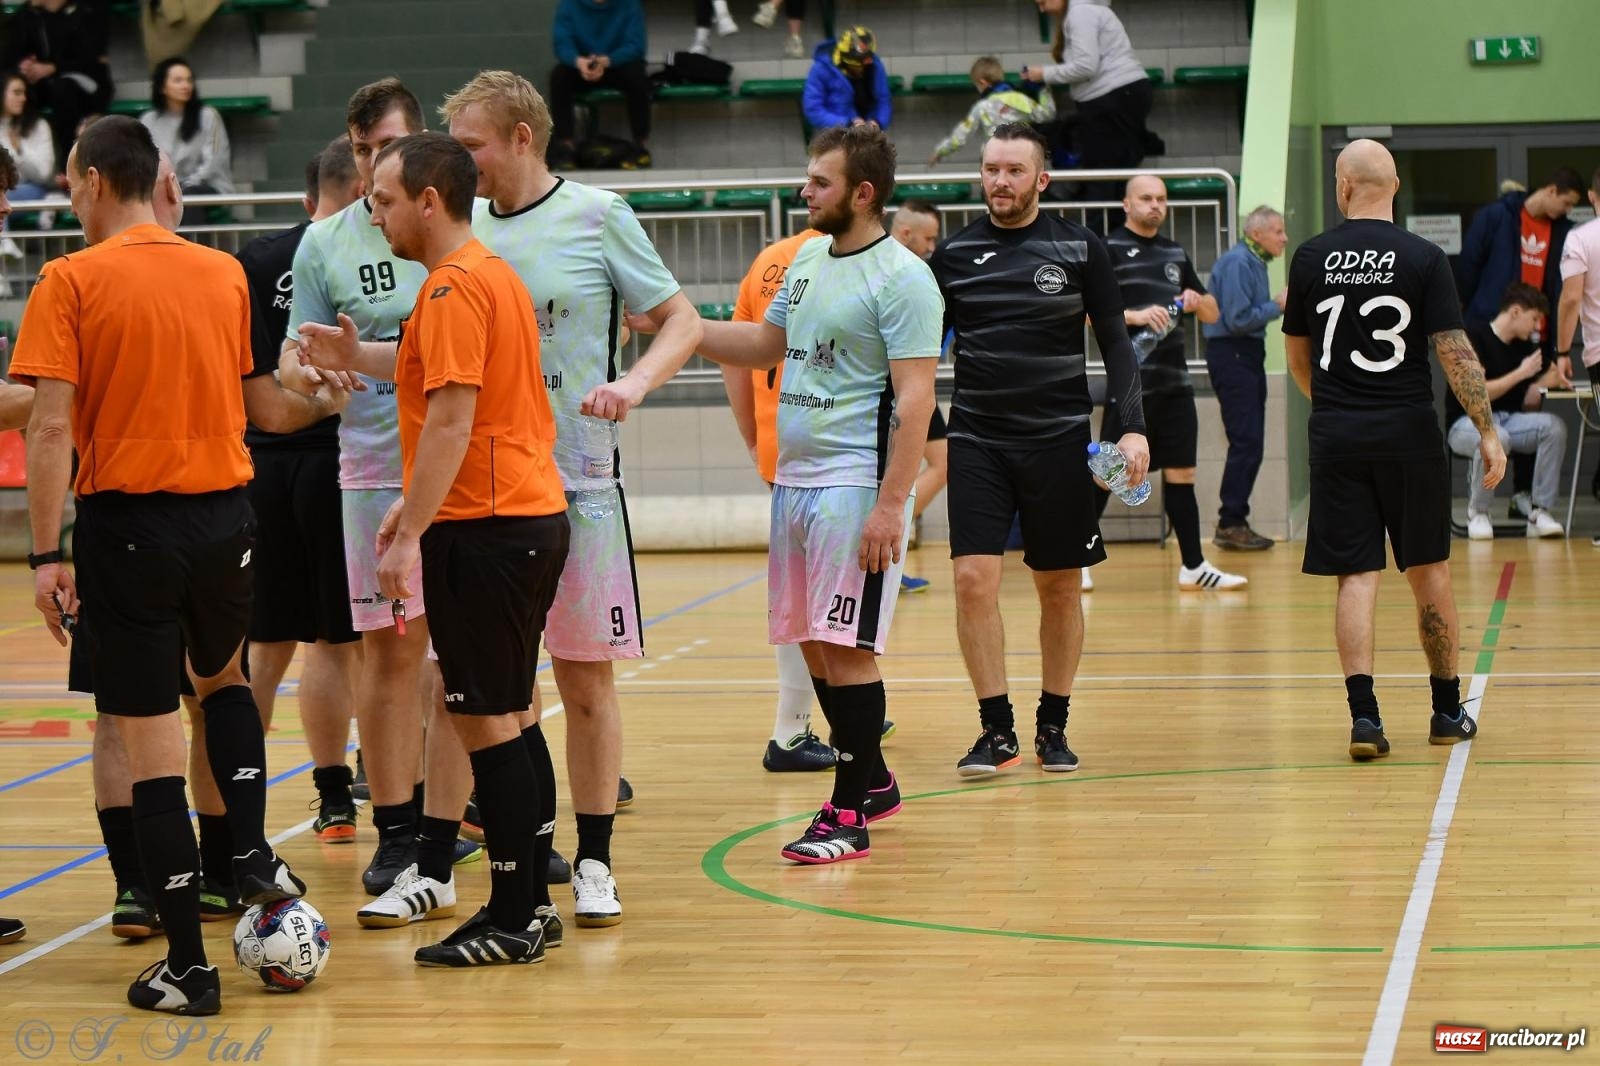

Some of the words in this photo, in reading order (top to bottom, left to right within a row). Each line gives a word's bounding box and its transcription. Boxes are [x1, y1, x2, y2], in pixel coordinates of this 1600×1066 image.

[1325, 250, 1396, 271] ODRA
[358, 260, 397, 296] 99
[788, 278, 809, 305] 20
[1325, 269, 1395, 285] RACIBÓRZ
[1315, 294, 1412, 373] 13
[610, 605, 625, 637] 9
[827, 594, 857, 625] 20
[290, 916, 312, 967] SELECT
